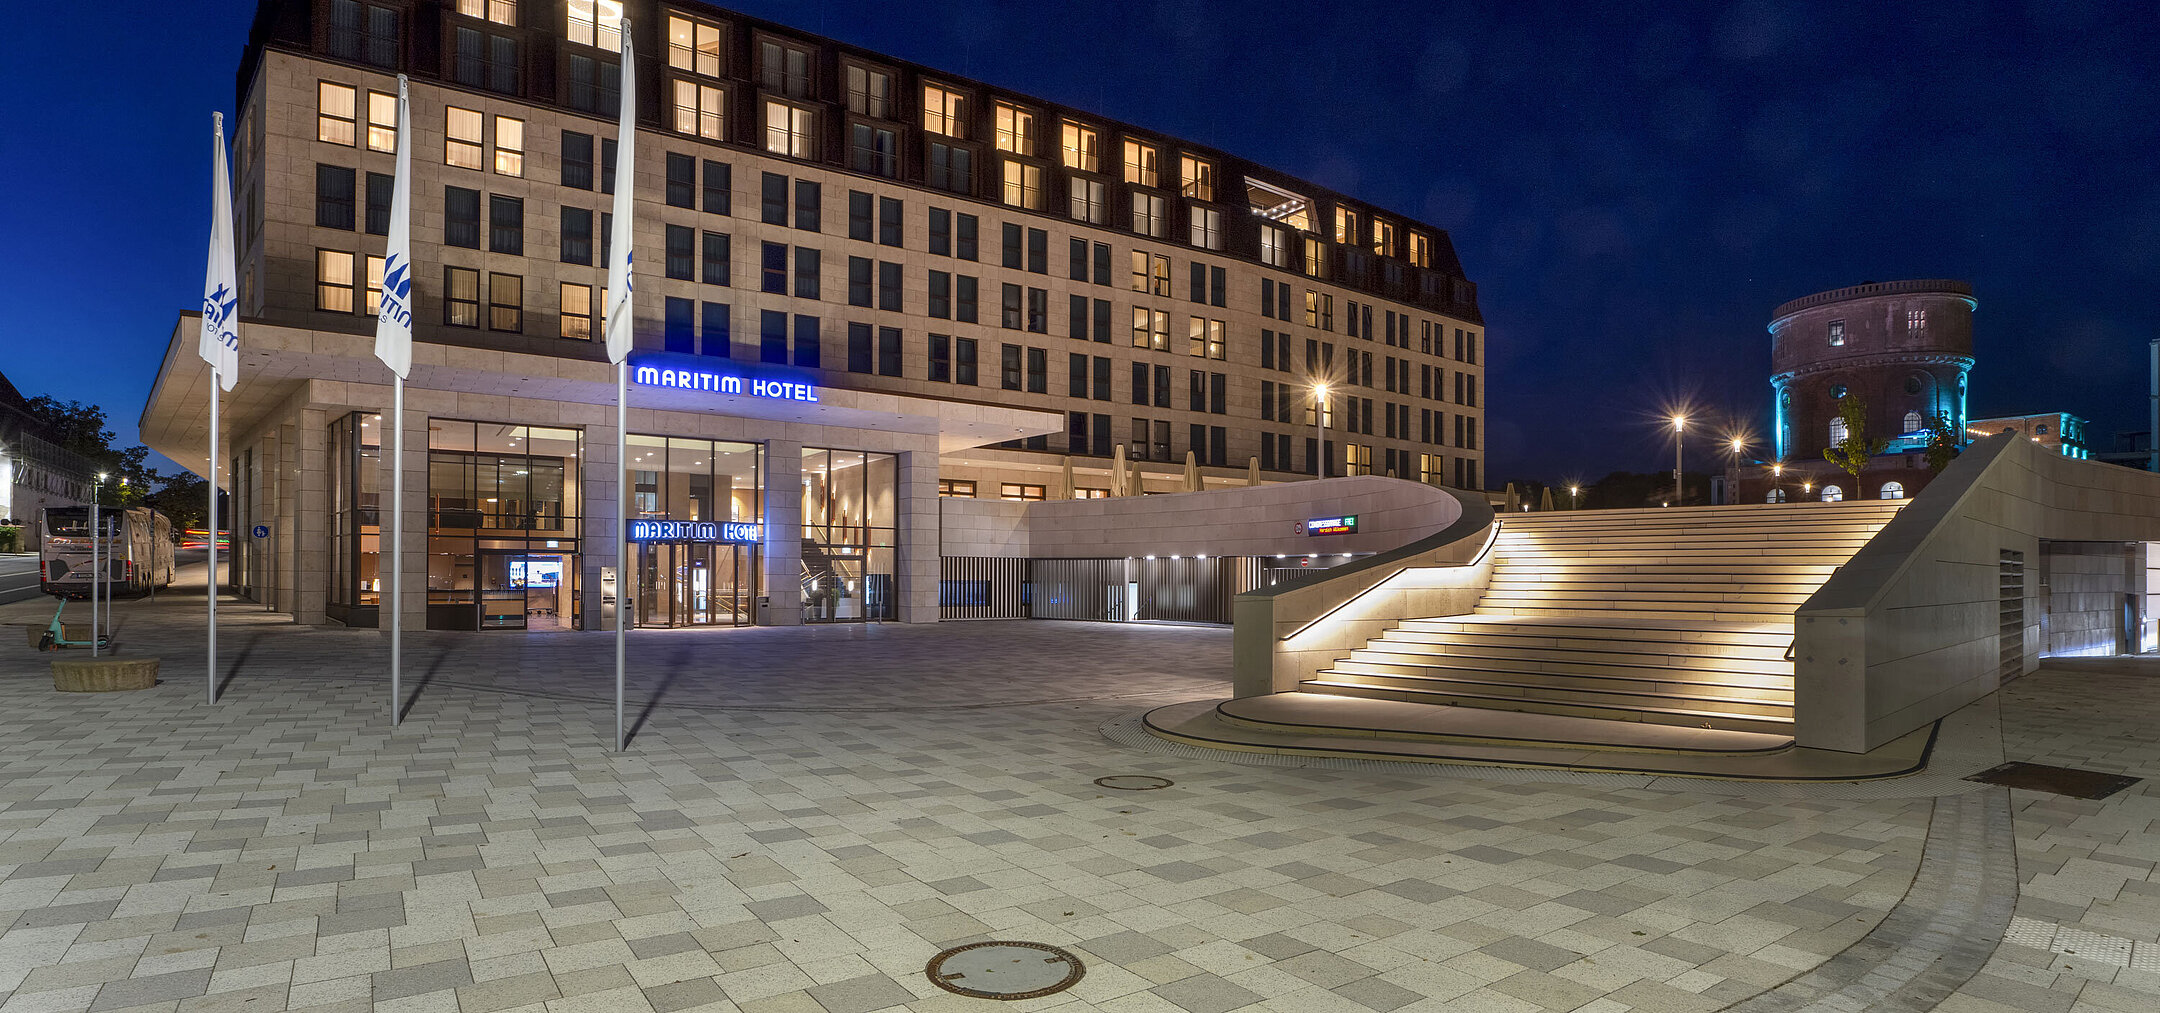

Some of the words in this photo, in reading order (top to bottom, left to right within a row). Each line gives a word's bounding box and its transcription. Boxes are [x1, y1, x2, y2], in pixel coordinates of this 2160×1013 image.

[637, 366, 741, 394] MARITIM
[753, 379, 817, 402] HOTEL
[634, 521, 717, 539] MARITIM
